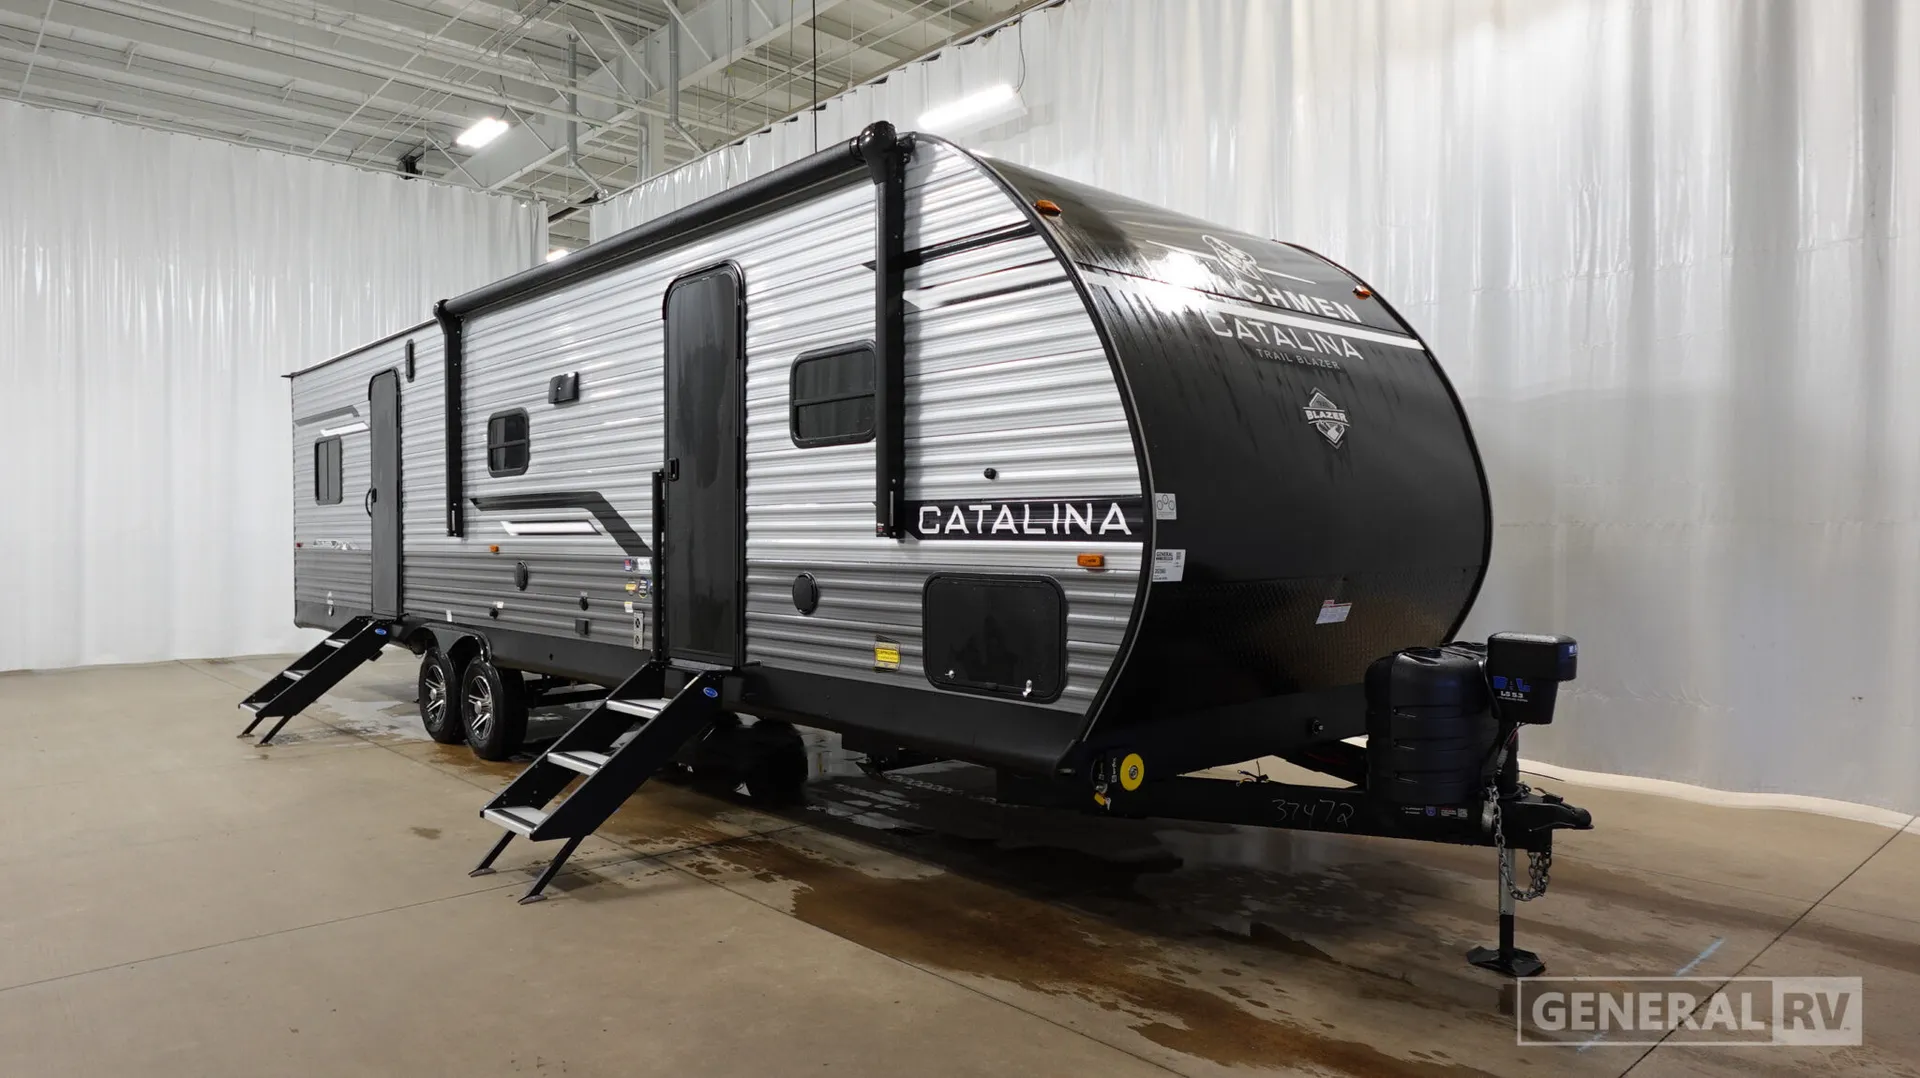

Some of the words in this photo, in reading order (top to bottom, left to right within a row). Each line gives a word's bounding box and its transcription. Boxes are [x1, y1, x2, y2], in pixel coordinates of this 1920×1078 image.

[1202, 310, 1364, 361] CATALINA
[1255, 348, 1293, 362] TRAIL
[1297, 356, 1341, 370] BLAZER
[1305, 410, 1348, 423] BLAZER
[918, 502, 1132, 536] CATALINA
[1272, 799, 1354, 829] 37472
